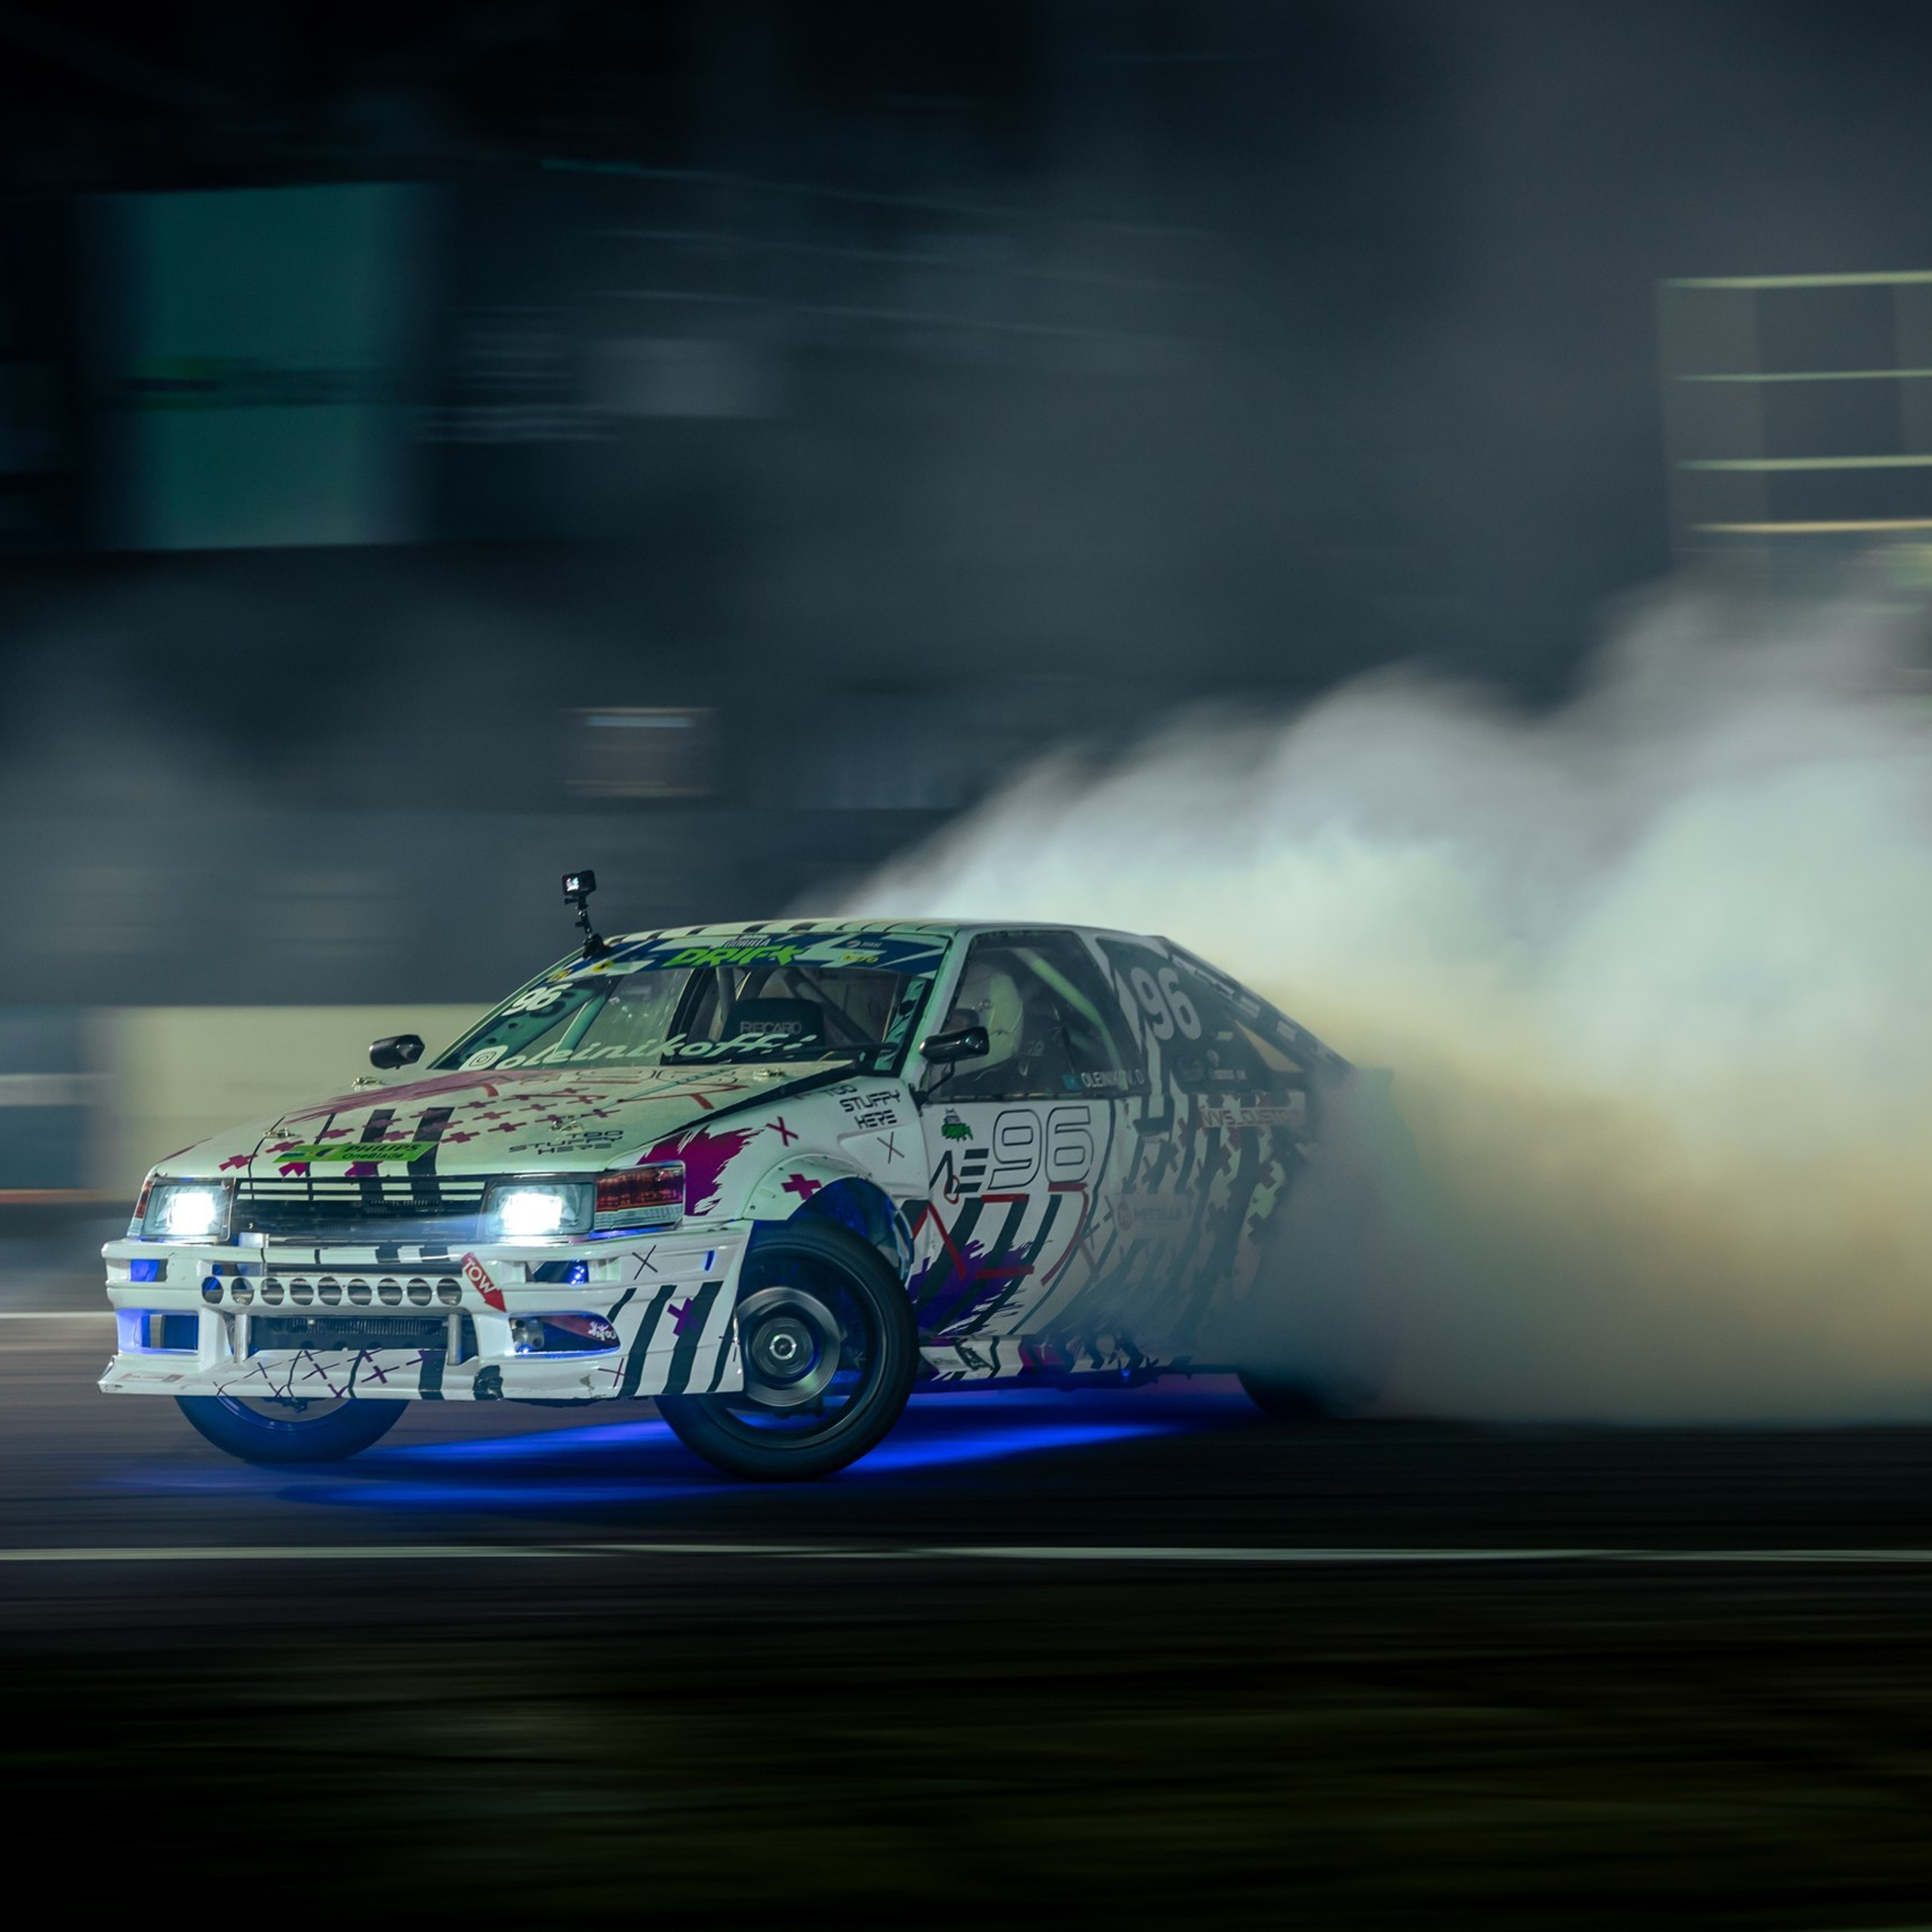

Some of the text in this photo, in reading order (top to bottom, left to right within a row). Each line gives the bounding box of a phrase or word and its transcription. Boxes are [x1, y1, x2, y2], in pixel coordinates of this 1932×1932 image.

[500, 983, 574, 1017] 96
[1130, 967, 1202, 1040] 96
[740, 1021, 802, 1035] RECARO
[839, 1089, 901, 1113] STUFFY
[854, 1109, 897, 1130] HERE
[344, 1143, 421, 1152] PHILIPS
[462, 1257, 501, 1294] TOW
